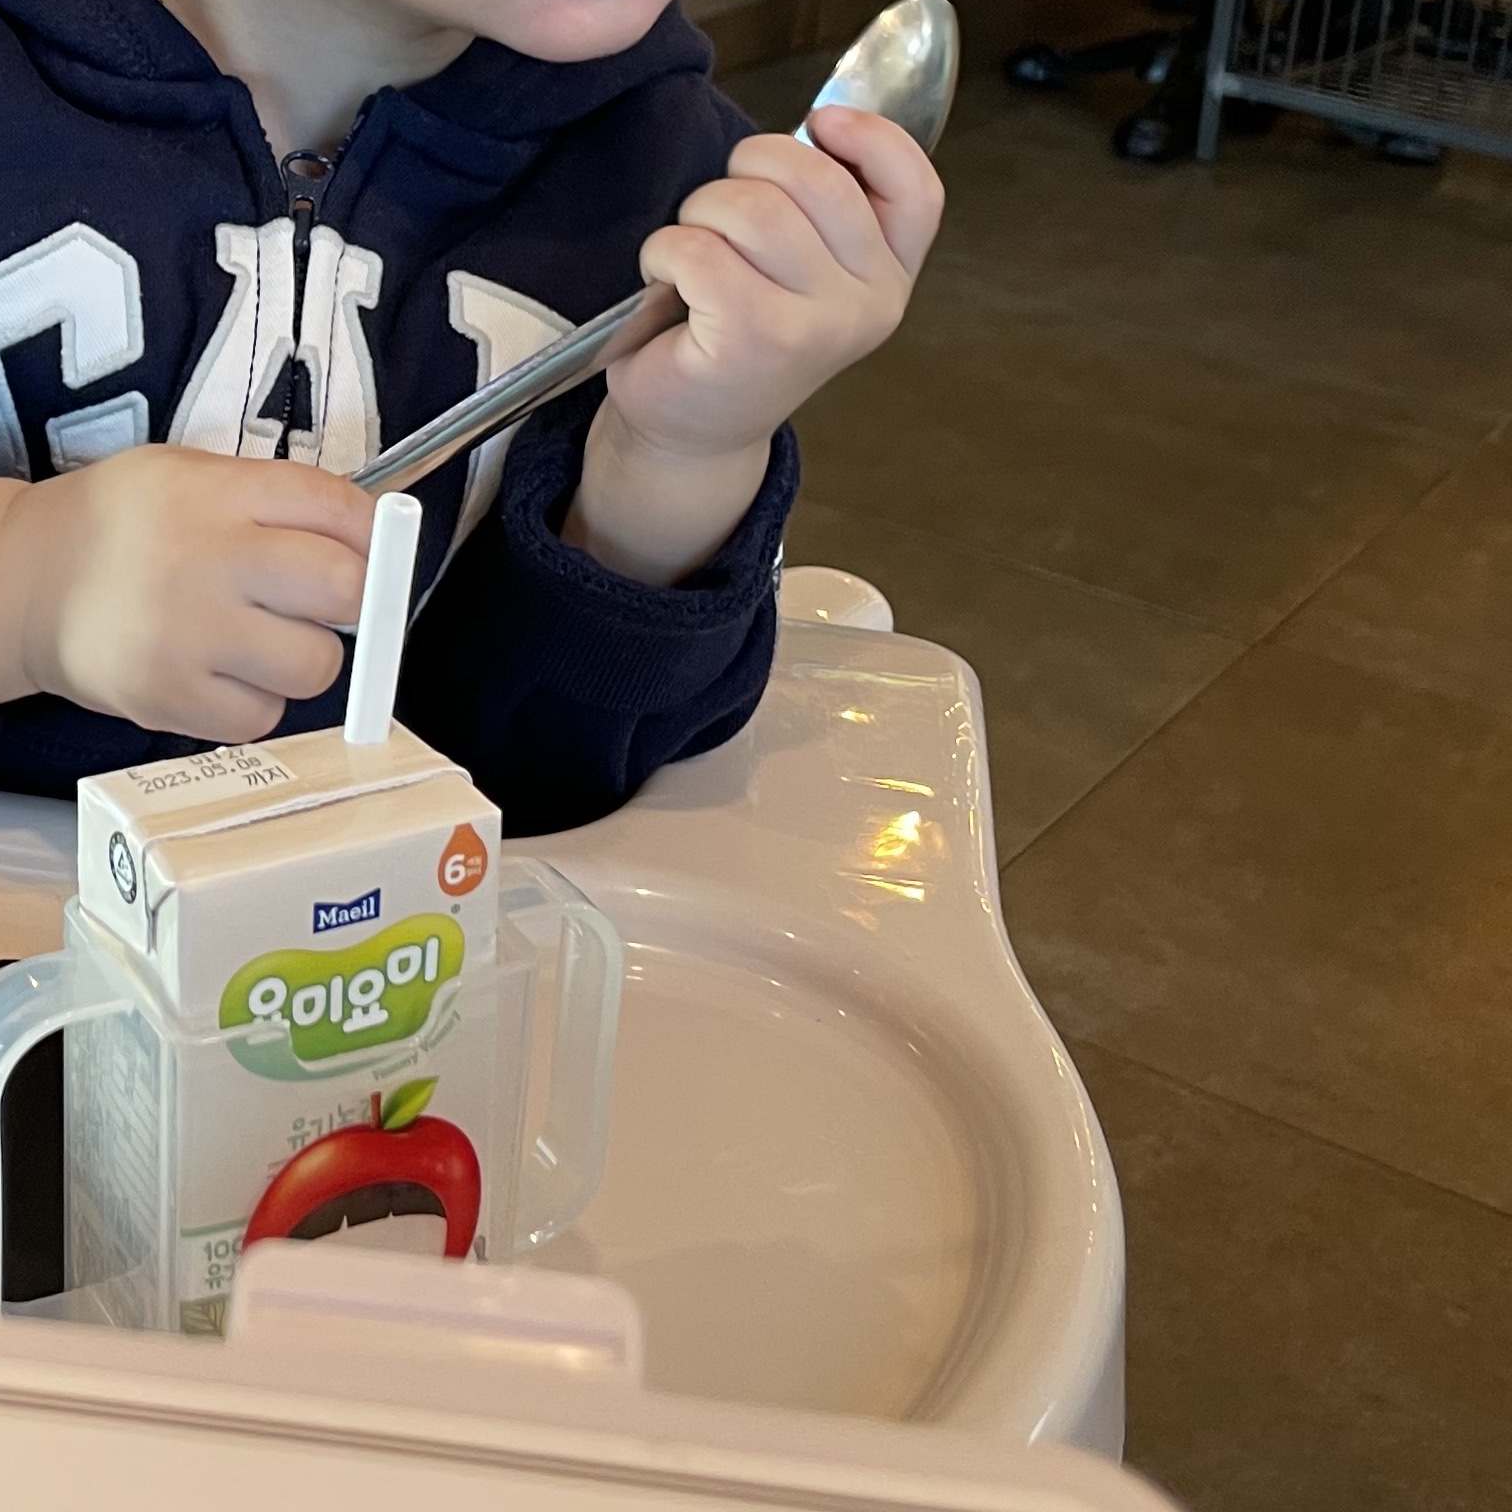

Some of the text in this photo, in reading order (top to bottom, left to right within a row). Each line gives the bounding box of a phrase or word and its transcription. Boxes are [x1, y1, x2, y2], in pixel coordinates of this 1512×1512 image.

[241, 765, 290, 787] 까지
[443, 853, 466, 885] 6
[317, 896, 376, 930] Maeil
[246, 935, 440, 1046] 요미요미
